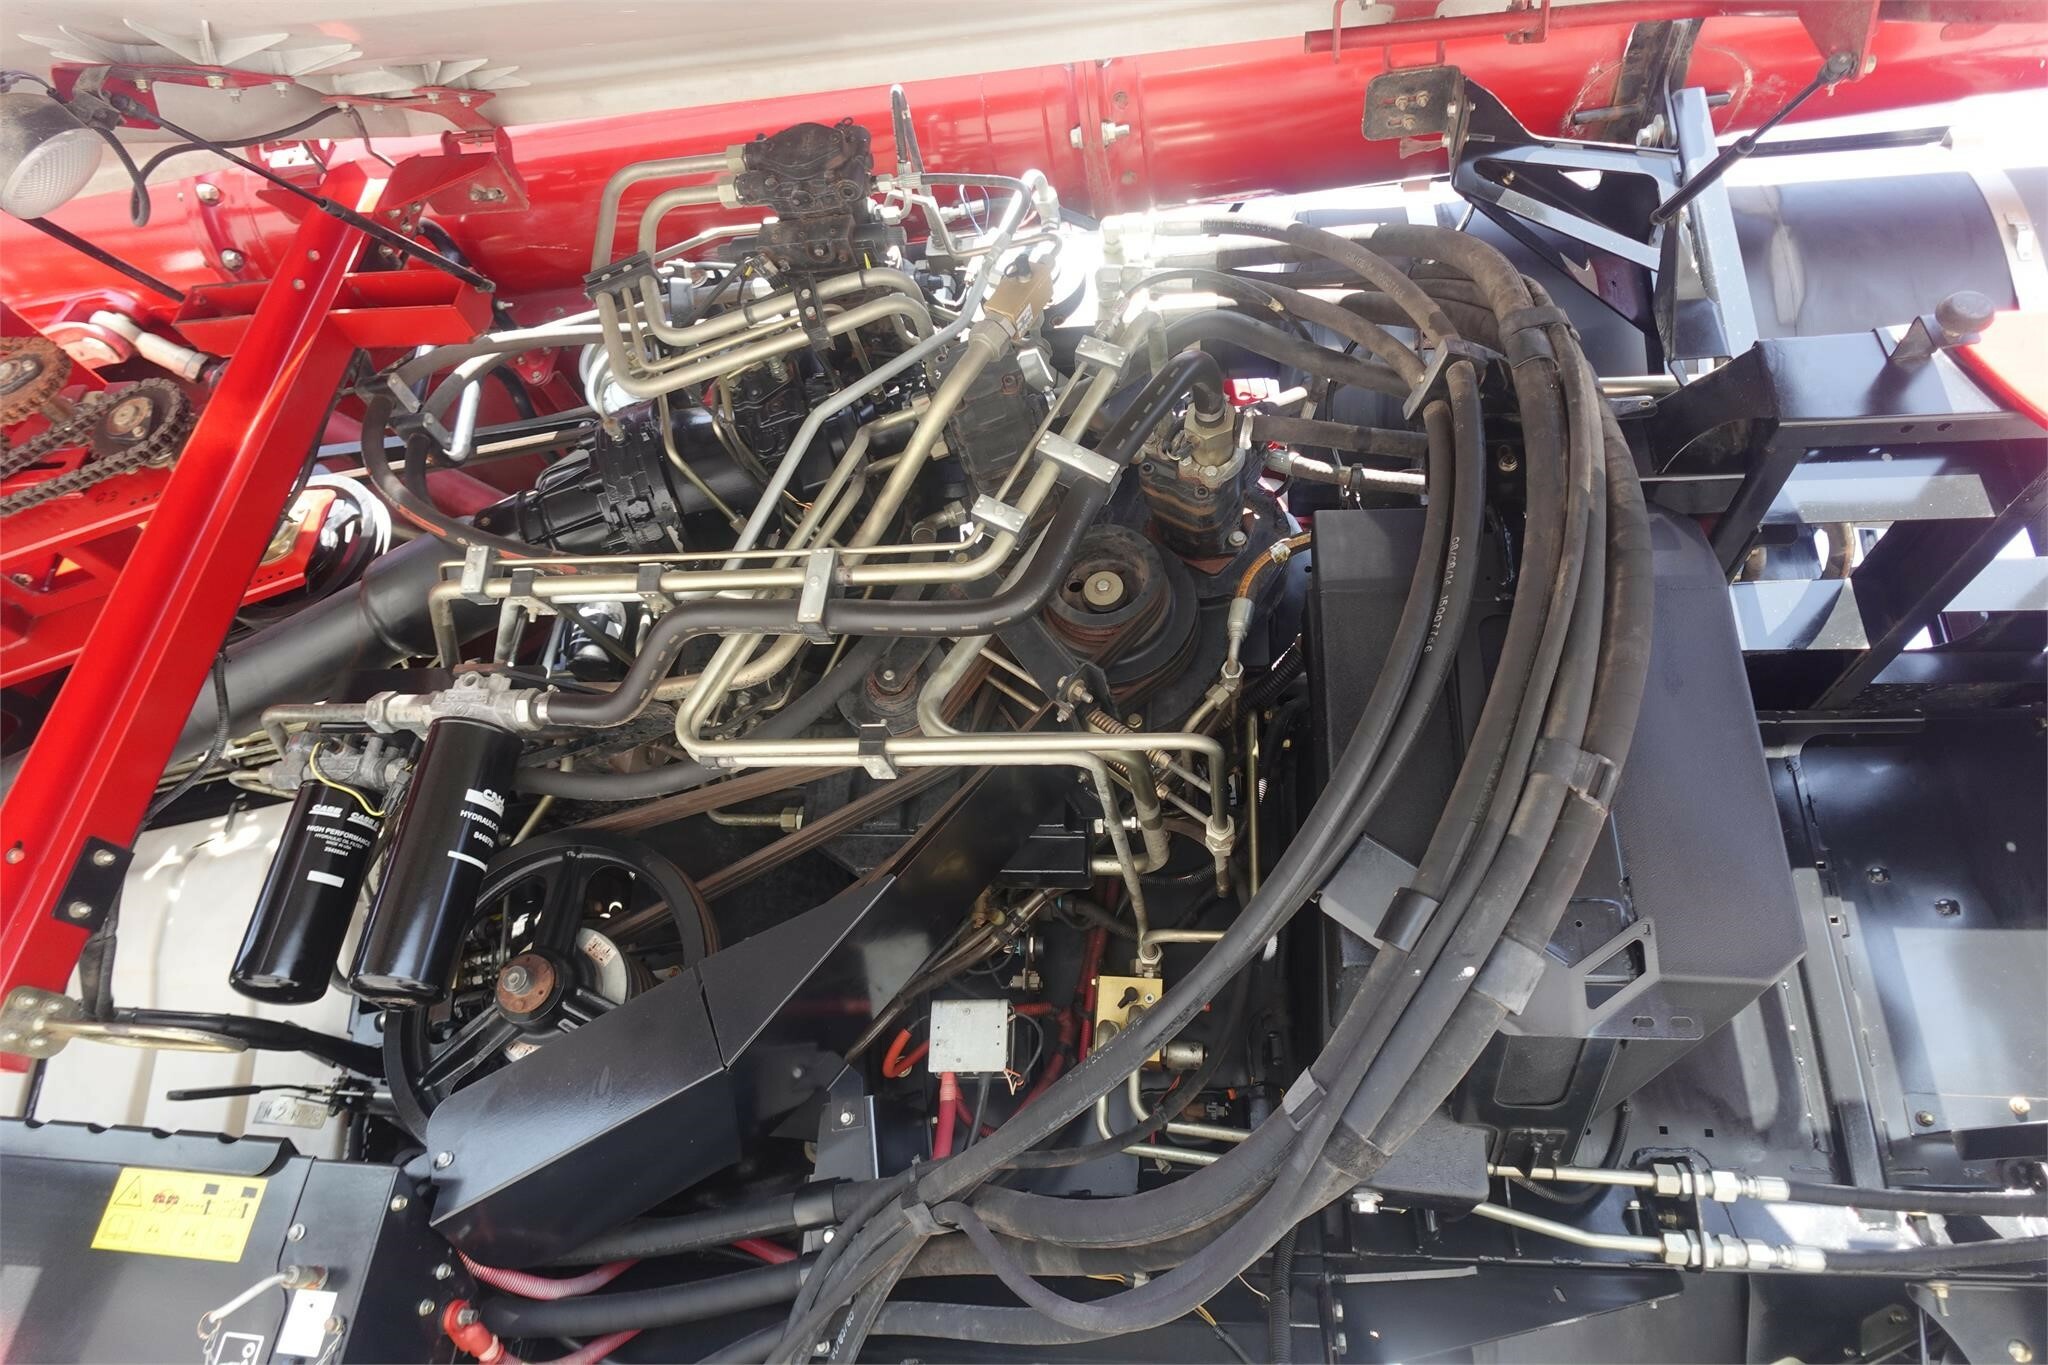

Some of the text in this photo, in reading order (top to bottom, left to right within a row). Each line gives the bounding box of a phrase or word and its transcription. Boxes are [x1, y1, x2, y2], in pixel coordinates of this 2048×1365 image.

[460, 809, 496, 830] HYDRAULIC
[306, 825, 370, 847] HIGH PERFORMANCE
[314, 833, 342, 842] HYDRAULIC
[350, 841, 363, 849] FILTER
